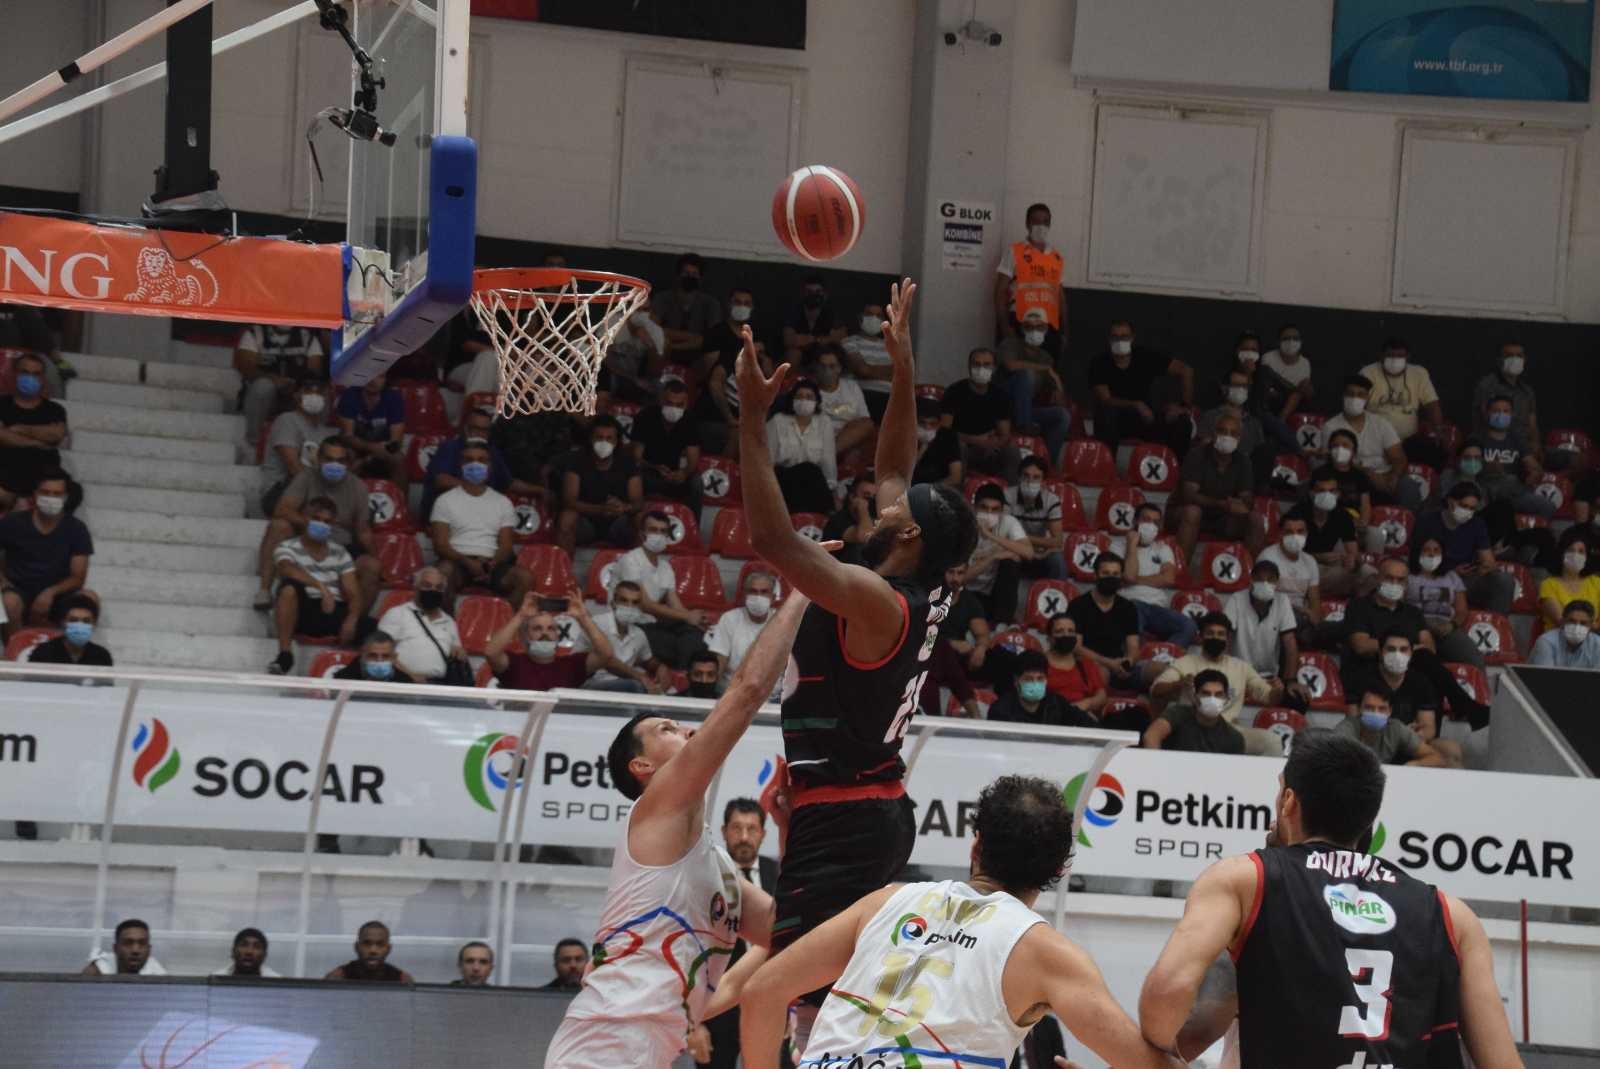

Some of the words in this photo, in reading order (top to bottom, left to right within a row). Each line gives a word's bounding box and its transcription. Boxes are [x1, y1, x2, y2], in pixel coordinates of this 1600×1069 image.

[1413, 59, 1504, 75] www.tbf.org.tr
[940, 202, 956, 218] G
[960, 207, 992, 221] BLOK
[193, 756, 385, 804] SOCAR
[543, 751, 610, 790] Pet
[1135, 789, 1272, 832] Petkim
[1135, 837, 1223, 860] SPOR
[1398, 831, 1574, 881] SOCAR
[1338, 948, 1394, 1040] 3
